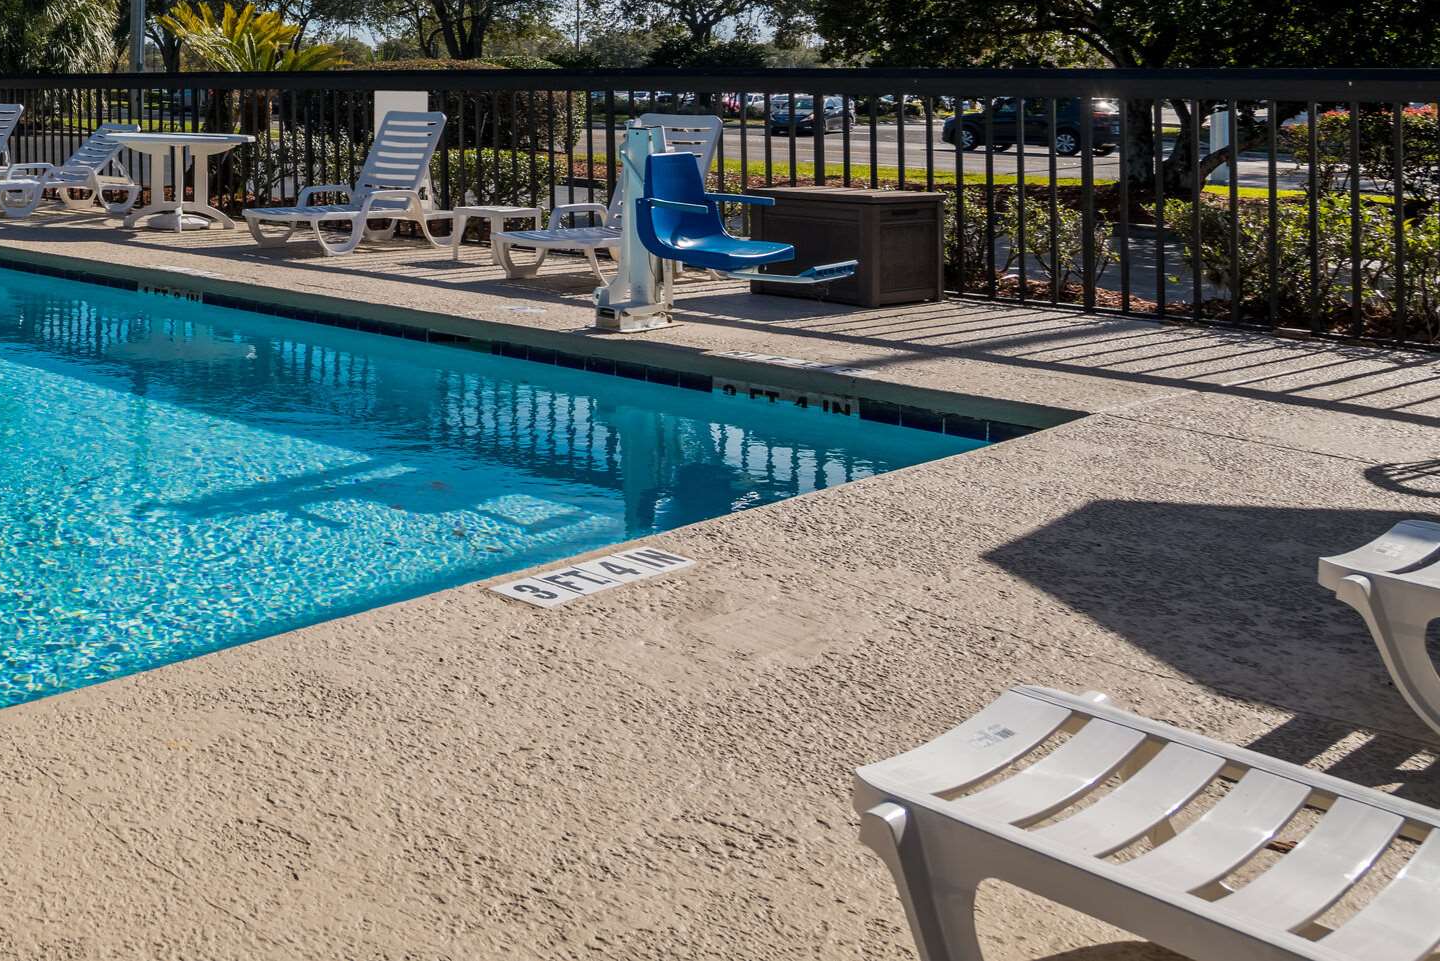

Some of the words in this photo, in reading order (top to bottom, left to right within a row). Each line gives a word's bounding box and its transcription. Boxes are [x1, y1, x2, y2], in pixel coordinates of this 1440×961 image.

[513, 584, 558, 600] 3
[598, 561, 641, 575] 4
[624, 549, 687, 568] IN
